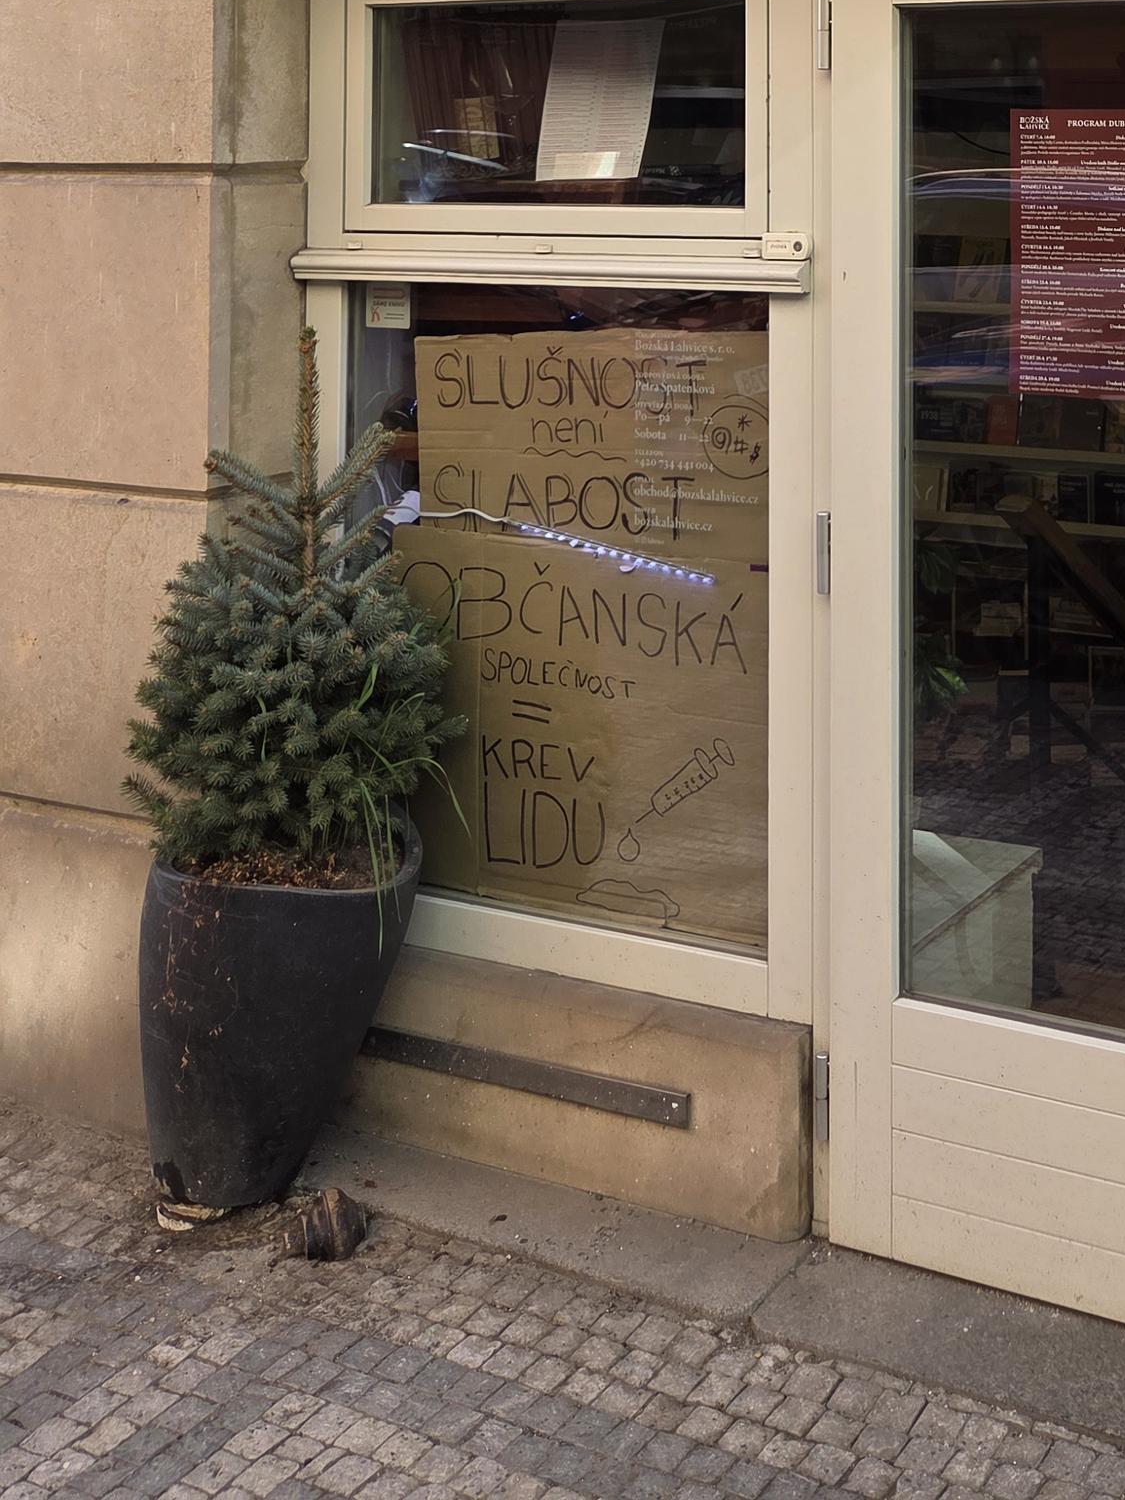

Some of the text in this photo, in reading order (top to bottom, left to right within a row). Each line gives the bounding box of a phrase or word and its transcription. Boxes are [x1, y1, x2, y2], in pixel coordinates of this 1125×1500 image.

[634, 340, 669, 352] Božská
[670, 341, 707, 354] Lahvice
[434, 345, 707, 417] SLUŠNOST
[635, 380, 659, 393] Petra
[531, 412, 608, 445] není
[634, 428, 667, 440] Sobota
[400, 561, 747, 674] OBČANSKÁ
[481, 648, 636, 699] SPOLEČNOST
[482, 734, 595, 782] KREV
[484, 781, 606, 868] LIDU
